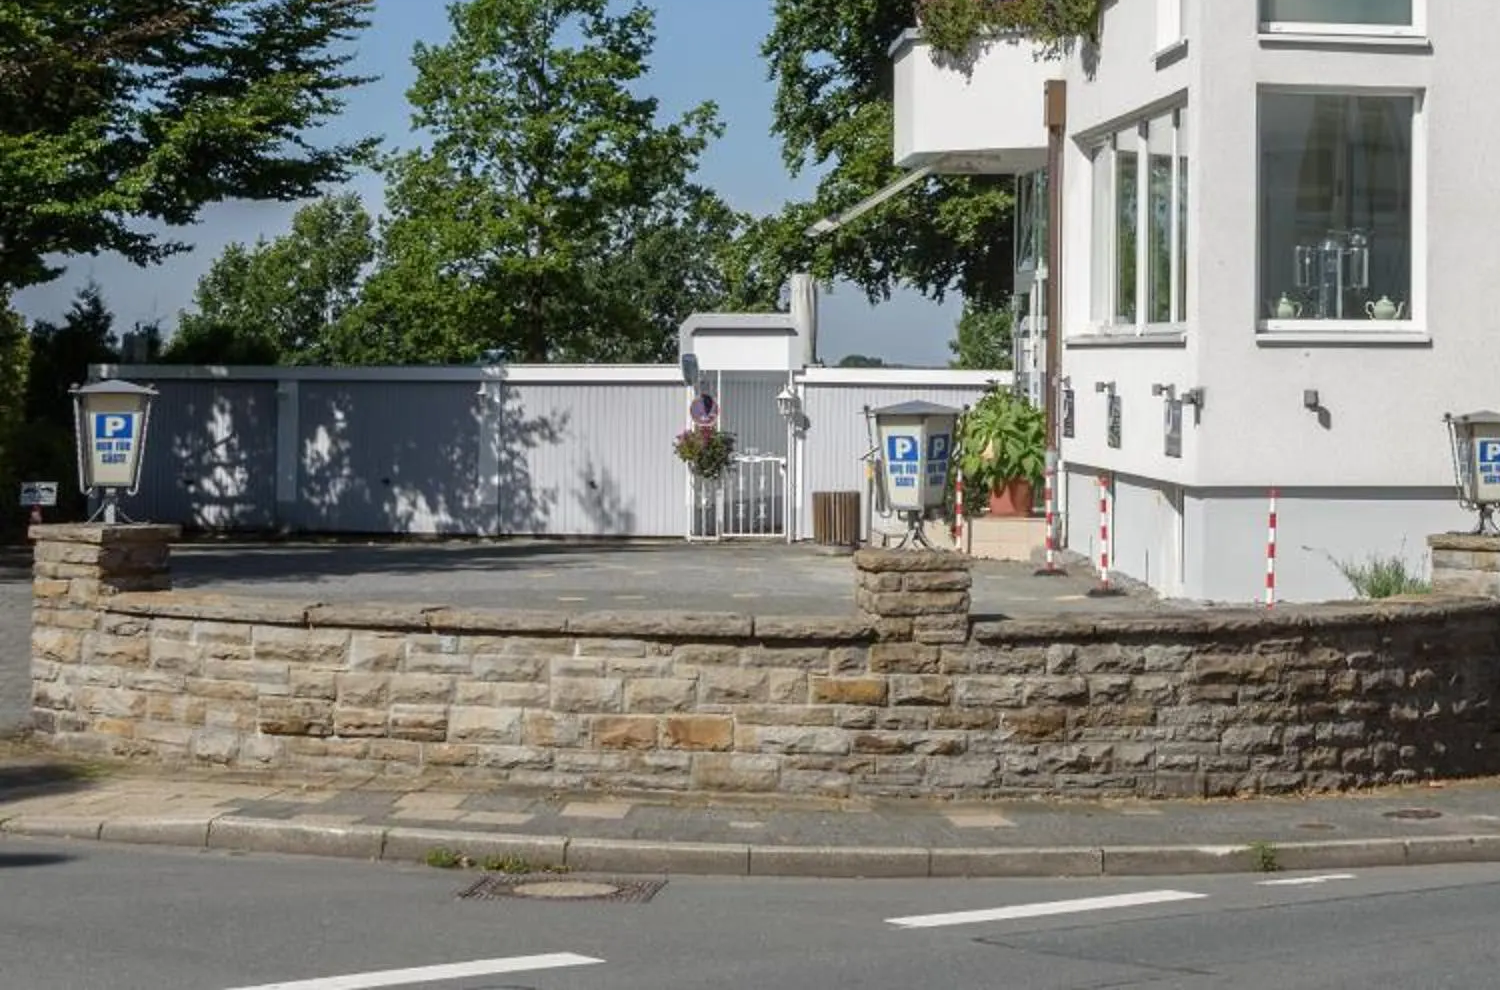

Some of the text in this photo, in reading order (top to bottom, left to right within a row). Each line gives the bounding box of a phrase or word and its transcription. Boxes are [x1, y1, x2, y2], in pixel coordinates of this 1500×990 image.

[105, 416, 126, 437] P
[895, 437, 913, 459] P
[933, 437, 945, 458] P
